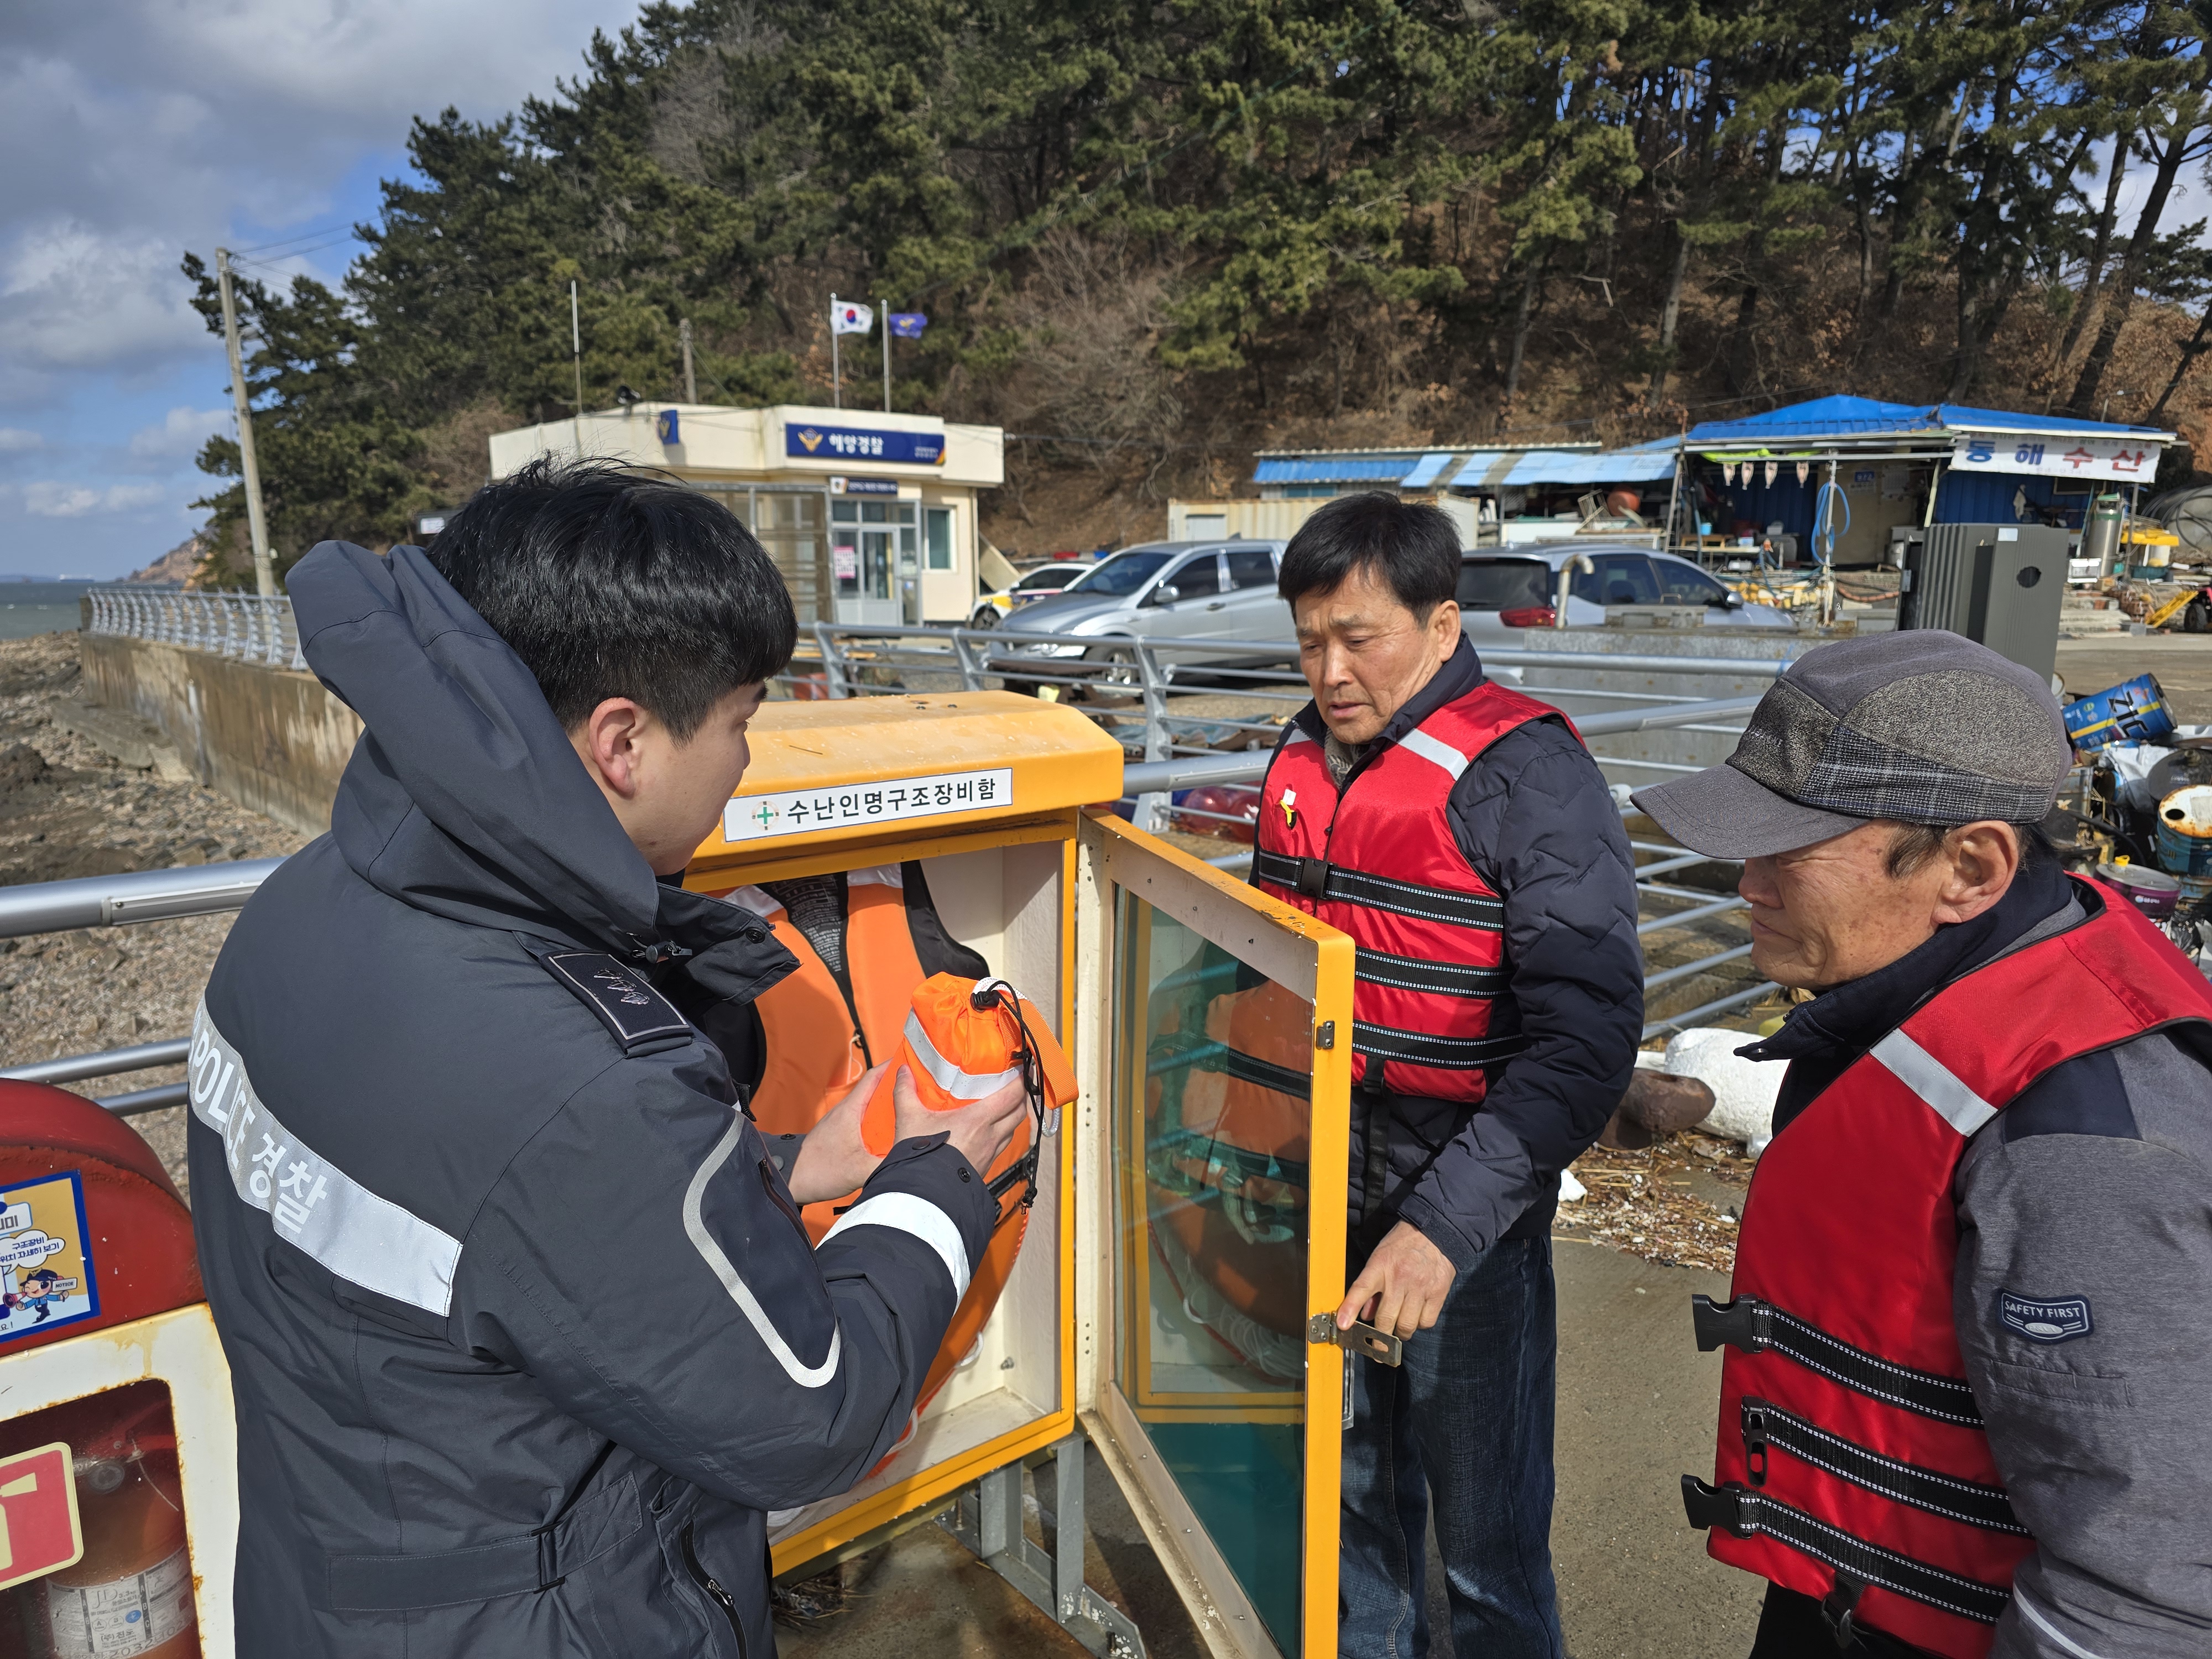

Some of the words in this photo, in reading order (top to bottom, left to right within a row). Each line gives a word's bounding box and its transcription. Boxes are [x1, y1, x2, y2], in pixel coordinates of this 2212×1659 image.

[828, 433, 884, 456] 해양경찰
[2107, 690, 2149, 737] ZIC
[787, 778, 996, 824] 수난인명구조장비함
[192, 1029, 256, 1170] POLICE
[249, 1133, 327, 1234] 경찰
[12, 1237, 44, 1250] 구조장비
[17, 1246, 42, 1259] 자세히
[43, 1242, 60, 1253] 보기
[2005, 1301, 2043, 1317] SAFETY
[2047, 1307, 2080, 1318] FIRST
